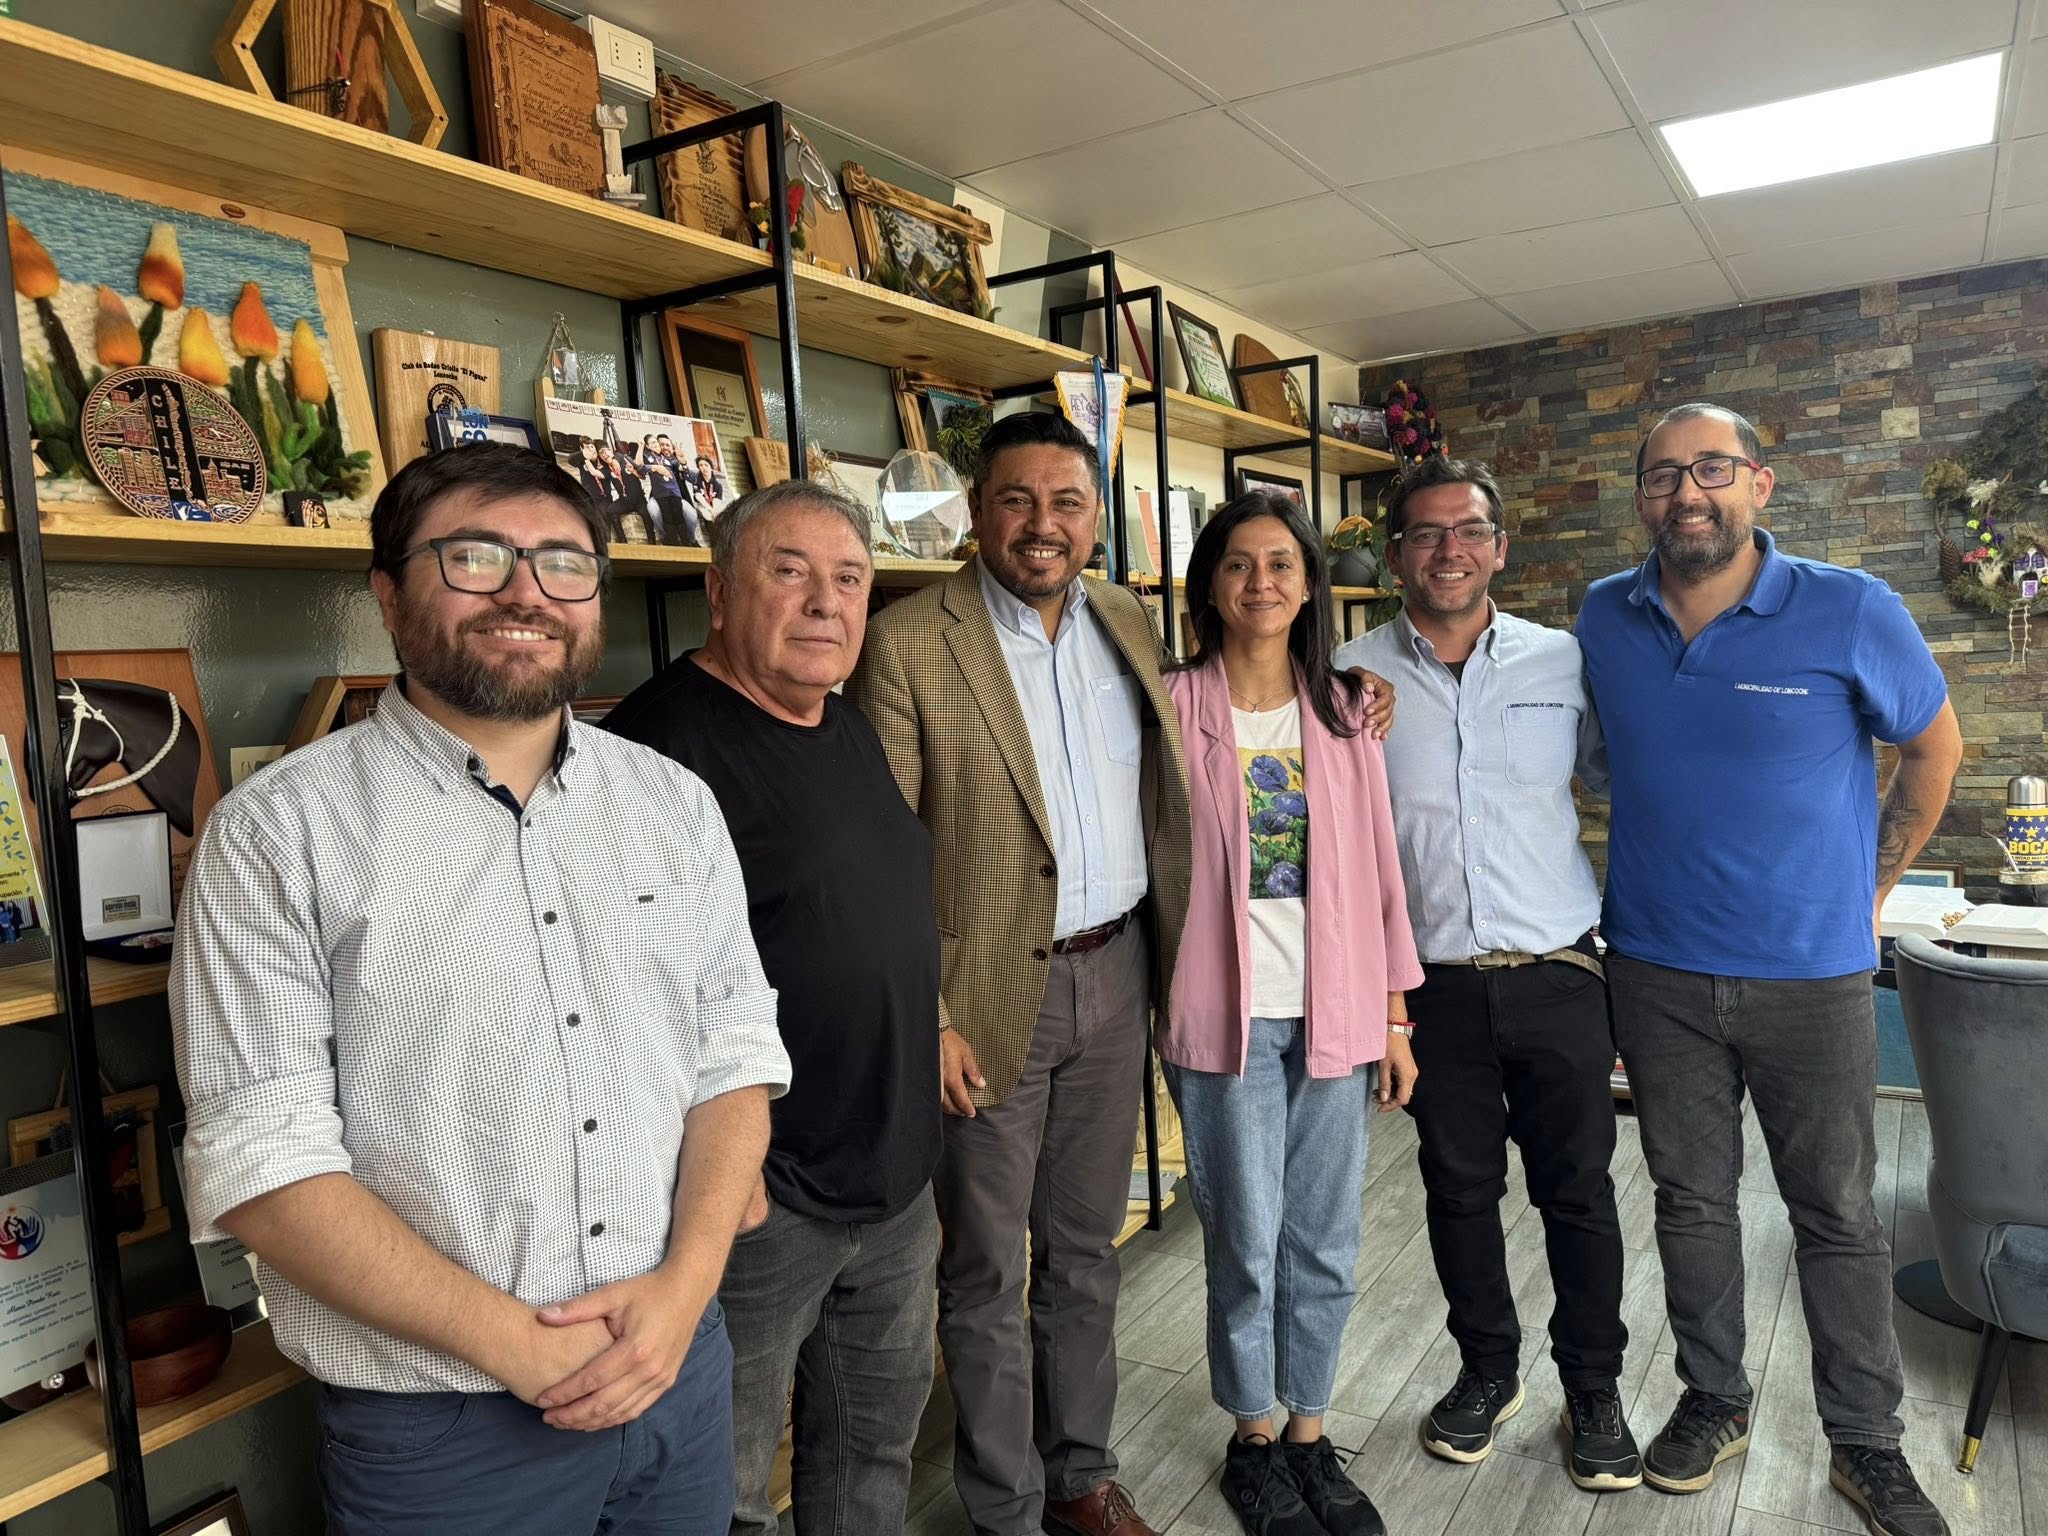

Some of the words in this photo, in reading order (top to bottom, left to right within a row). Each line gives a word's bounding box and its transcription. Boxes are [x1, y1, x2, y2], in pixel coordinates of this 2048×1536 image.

[401, 362, 415, 370] Club
[151, 394, 183, 490] CHILE
[2009, 841, 2048, 855] BOCA
[0, 889, 23, 898] upación
